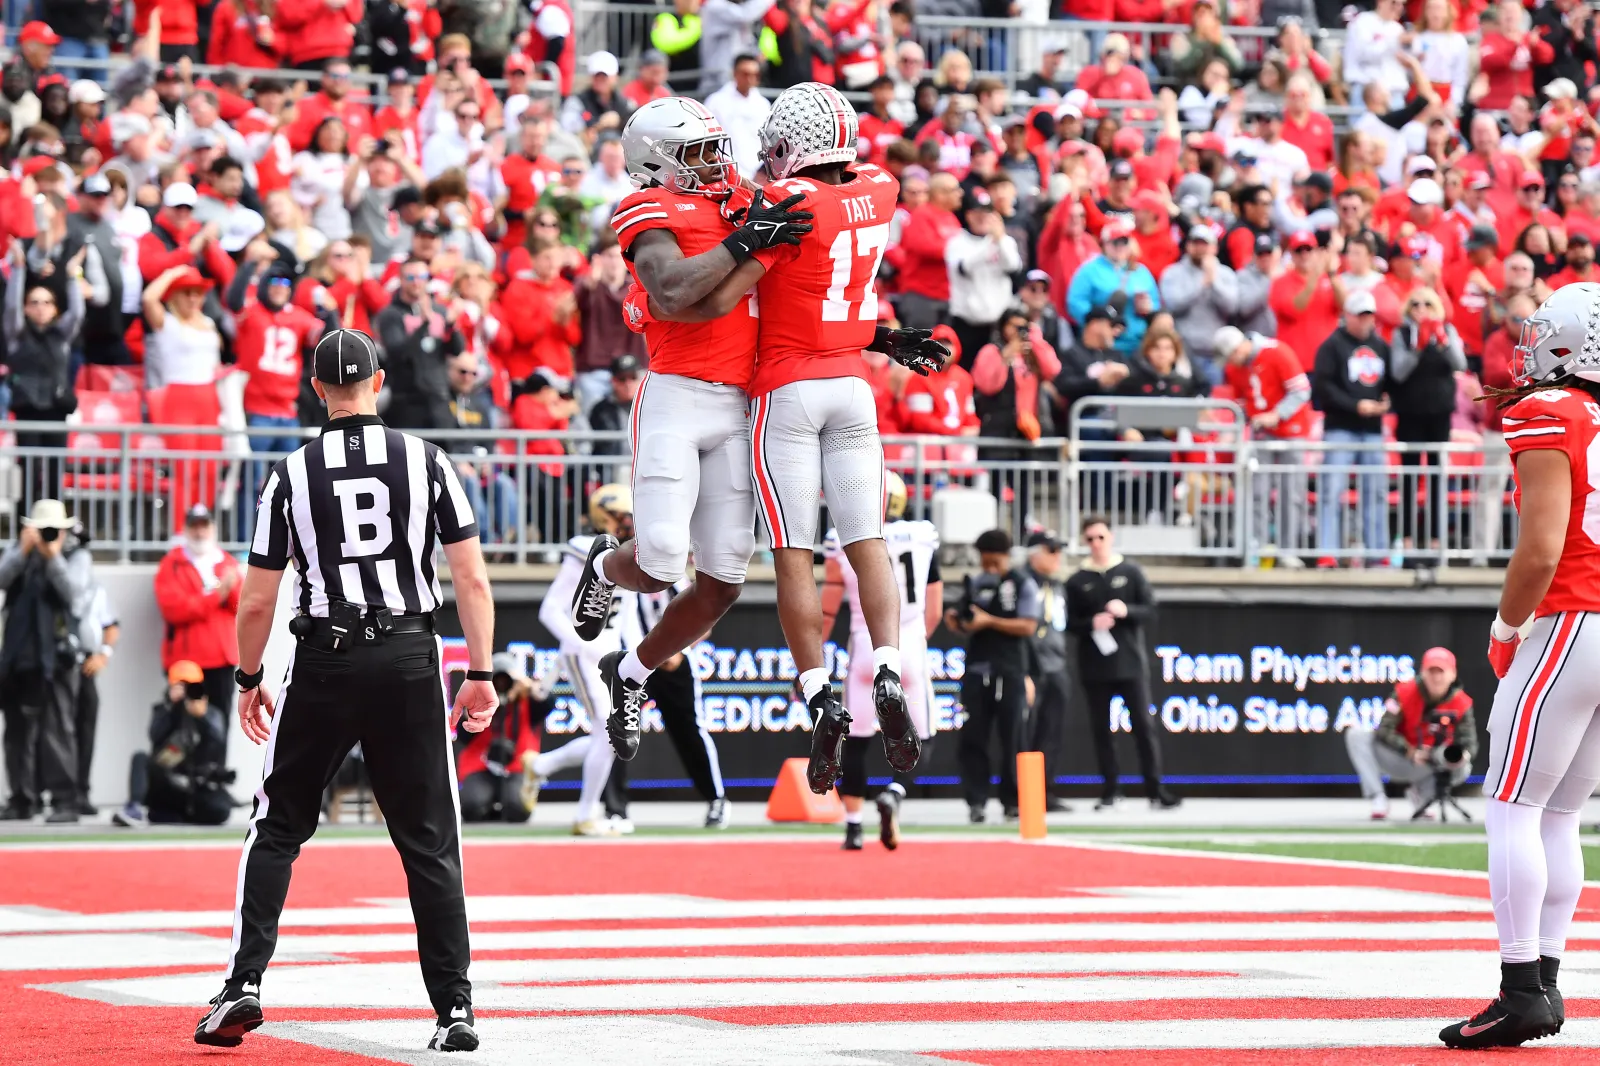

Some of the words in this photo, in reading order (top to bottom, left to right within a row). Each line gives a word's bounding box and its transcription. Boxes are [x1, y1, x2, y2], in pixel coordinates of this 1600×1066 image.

[841, 195, 877, 224] TATE
[821, 222, 890, 321] 17
[258, 325, 298, 376] 12
[346, 364, 358, 374] RR
[332, 477, 393, 558] B
[897, 551, 917, 604] 1
[697, 641, 800, 681] STATE
[1155, 645, 1244, 683] Team
[1250, 645, 1415, 691] Physicians
[702, 695, 814, 732] EDICA
[1161, 693, 1239, 733] Ohio
[1243, 695, 1329, 733] State
